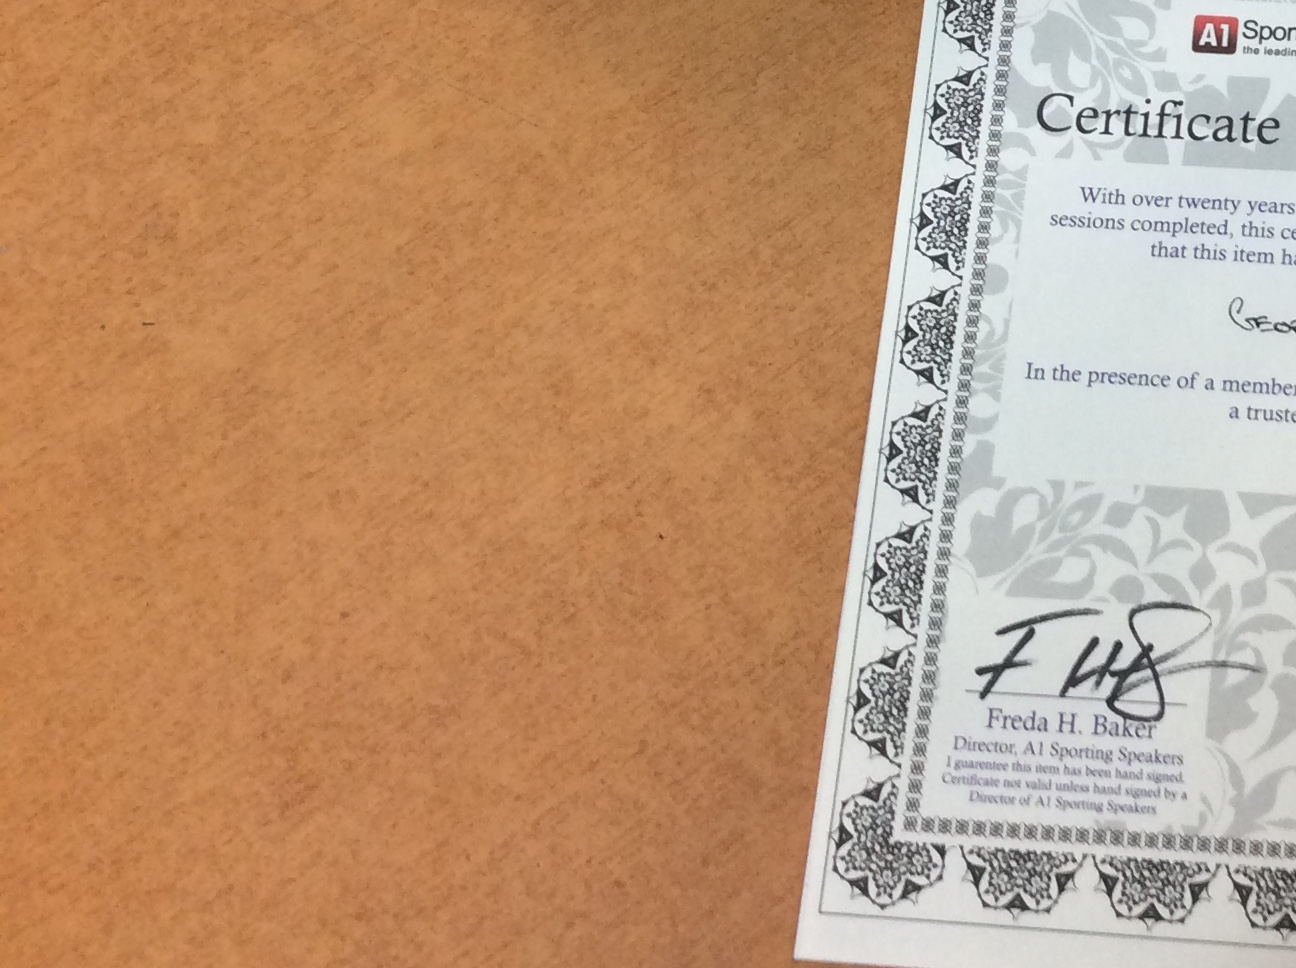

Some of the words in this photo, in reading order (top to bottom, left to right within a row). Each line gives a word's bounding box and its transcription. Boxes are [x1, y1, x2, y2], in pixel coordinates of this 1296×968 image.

[1198, 22, 1230, 47] A1
[1242, 45, 1260, 56] the
[1036, 92, 1281, 146] Certificate
[1080, 186, 1126, 207] With
[1131, 192, 1173, 209] over
[1177, 194, 1241, 216] twenty
[1246, 198, 1296, 217] years
[1049, 212, 1125, 232] sessions
[1130, 217, 1235, 240] completed,
[1240, 221, 1276, 240] this
[1149, 240, 1187, 260] that
[1193, 242, 1228, 262] this
[1233, 244, 1276, 265] item
[1025, 362, 1046, 381] In
[1051, 363, 1082, 383] the
[1086, 369, 1172, 388] presence
[1176, 371, 1201, 390] of
[1204, 376, 1215, 391] a
[1228, 405, 1240, 420] a
[985, 706, 1048, 732] Freda
[1056, 711, 1083, 736] H.
[1091, 713, 1158, 740] Baker
[953, 735, 1018, 757] Director,
[1023, 740, 1044, 757] A1
[1049, 741, 1114, 765] Sporting
[1118, 746, 1184, 767] Speakers
[1011, 760, 1032, 773] this
[1035, 762, 1060, 775] item
[1063, 763, 1082, 777] has
[1085, 765, 1112, 779] been
[1115, 767, 1144, 781] hand
[941, 771, 1000, 788] Certificate
[1003, 778, 1022, 790] not
[1025, 777, 1052, 791] valid
[1055, 779, 1090, 793] unless
[1093, 782, 1122, 796] hand
[1124, 785, 1161, 800] signed
[1164, 786, 1177, 802] by
[969, 789, 1017, 806] Director
[1019, 793, 1034, 807] of
[1054, 795, 1104, 814] Sporting
[1107, 799, 1157, 815] Speakers
